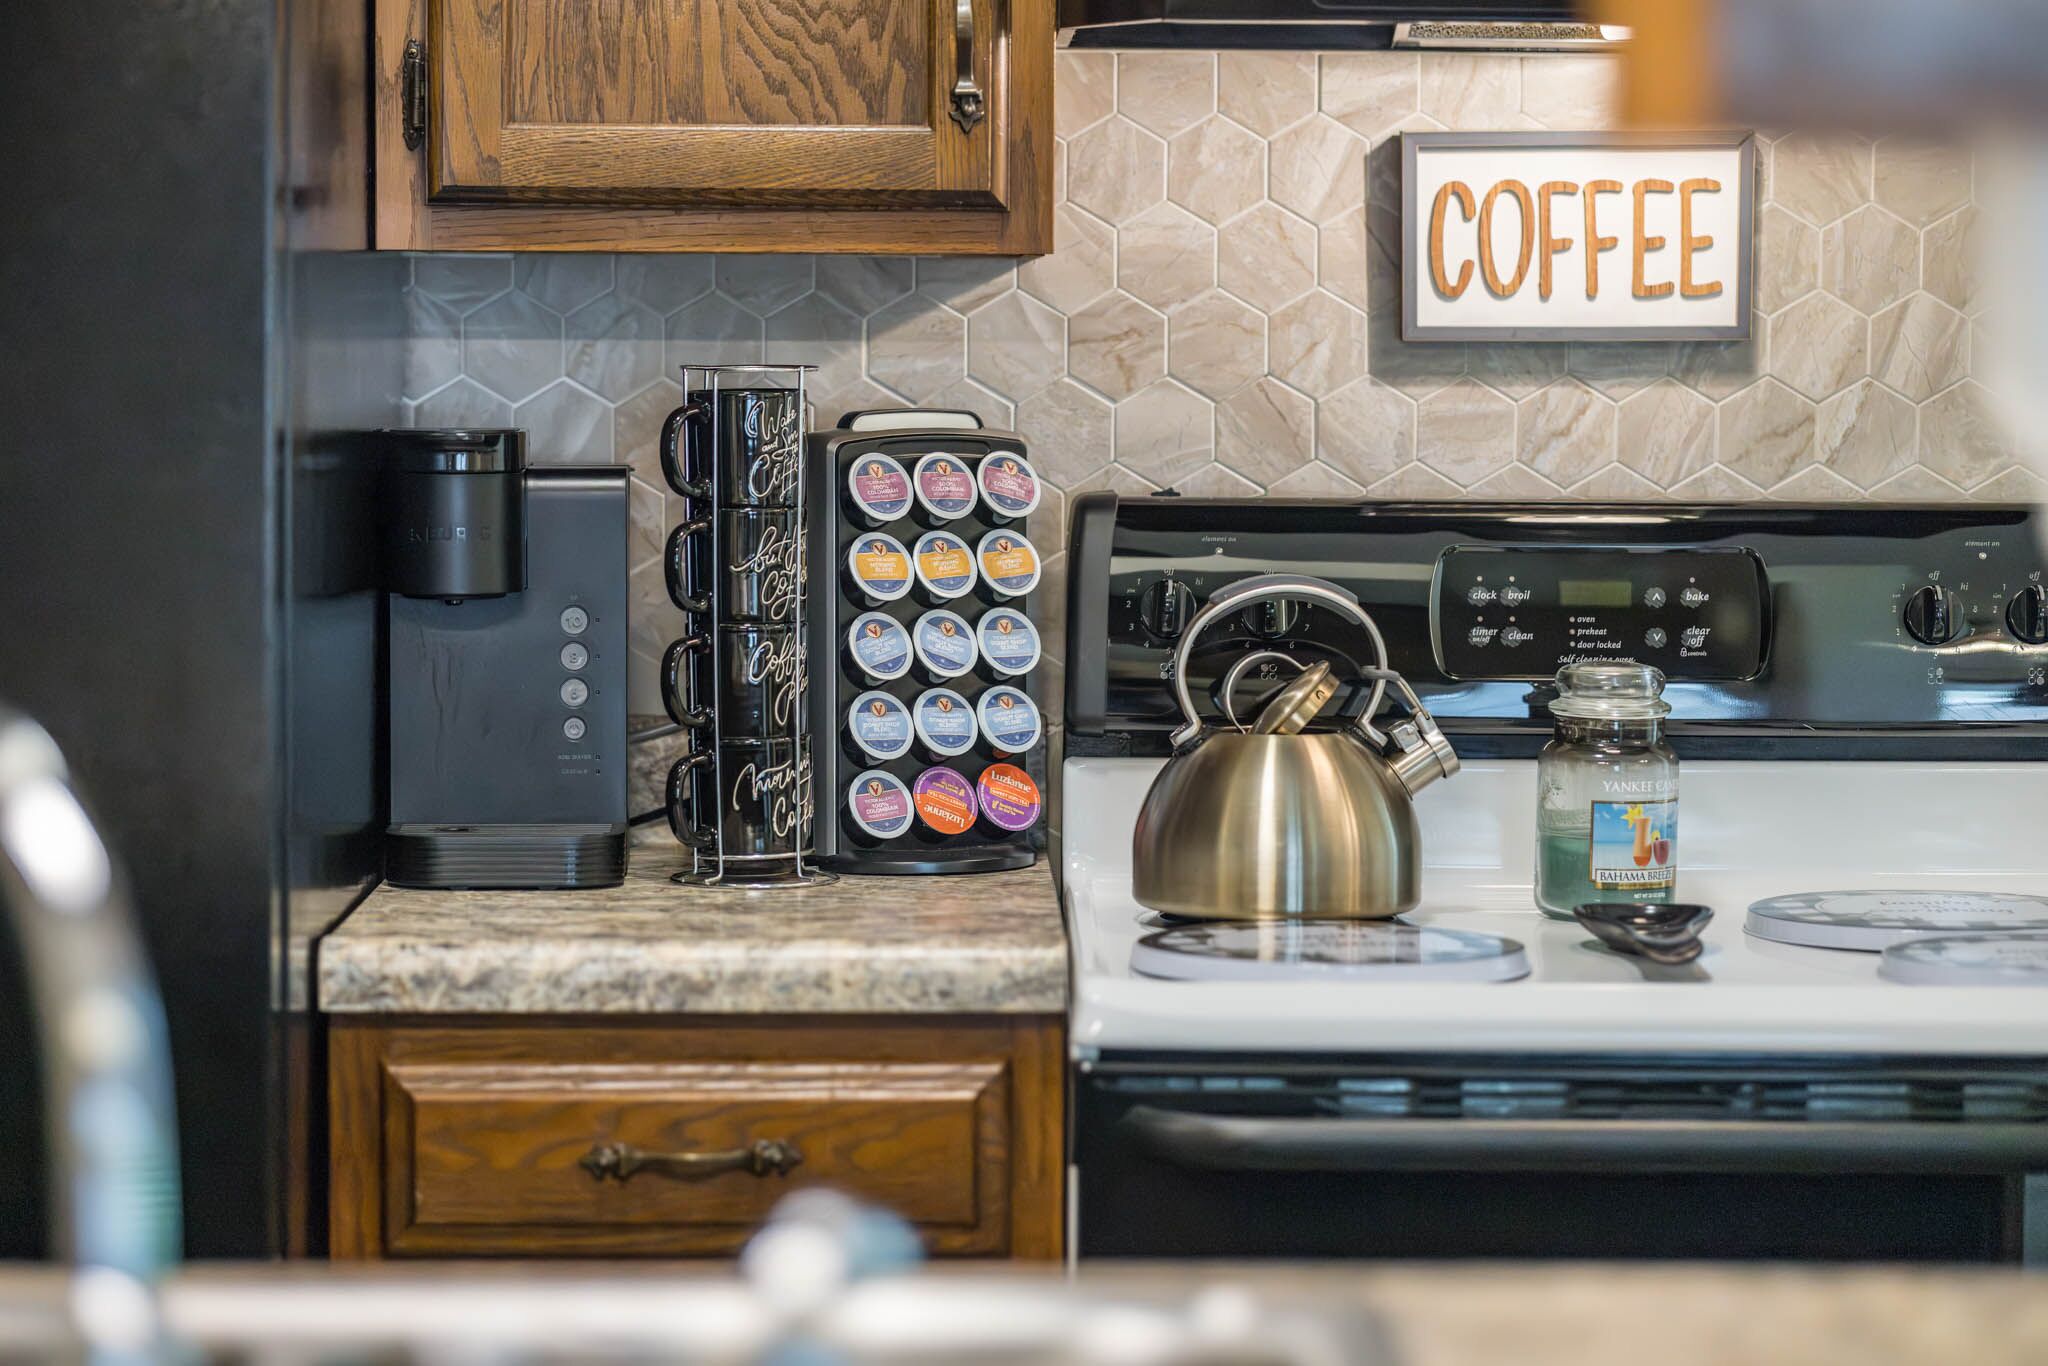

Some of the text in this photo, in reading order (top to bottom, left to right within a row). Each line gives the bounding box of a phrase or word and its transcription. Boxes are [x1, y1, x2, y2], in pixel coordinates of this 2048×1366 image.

[1431, 178, 1723, 299] COFFEE
[1928, 570, 1941, 580] off
[2029, 570, 2041, 581] off
[1960, 582, 1969, 591] hi
[1472, 590, 1498, 600] clock
[1507, 590, 1531, 600] broil
[1686, 591, 1710, 601] bake
[1472, 626, 1499, 636] timer
[1508, 630, 1534, 640] clean
[1577, 626, 1608, 637] preheat
[1687, 625, 1711, 635] clear
[1577, 640, 1622, 649] door locked
[1687, 635, 1705, 648] /off
[749, 633, 807, 682] Coffe
[1557, 654, 1576, 664] Self
[733, 753, 812, 810] Mornng
[991, 770, 1031, 793] Luzianne
[1602, 780, 1655, 793] YANKEE
[923, 804, 965, 829] Luzianne
[1600, 871, 1646, 881] BAHAMA
